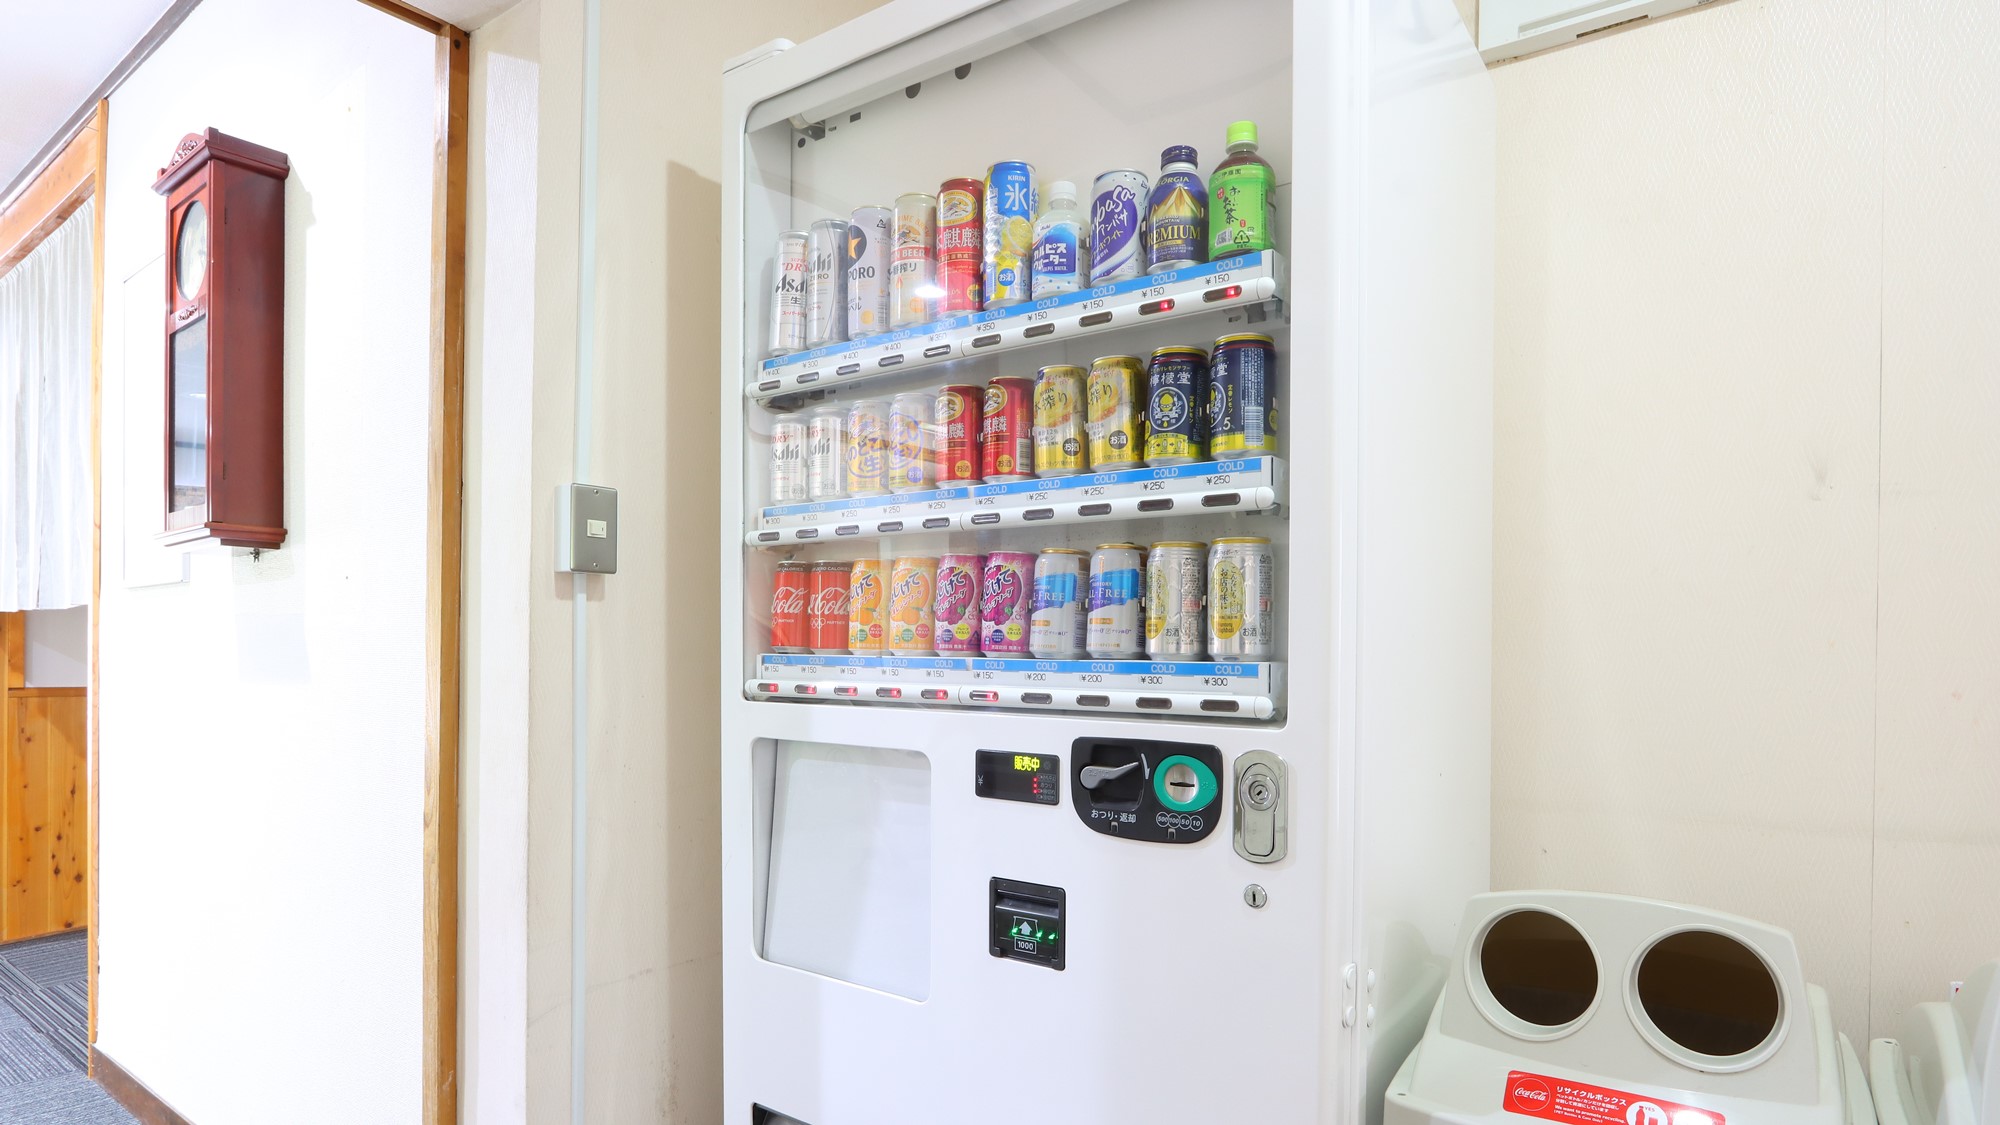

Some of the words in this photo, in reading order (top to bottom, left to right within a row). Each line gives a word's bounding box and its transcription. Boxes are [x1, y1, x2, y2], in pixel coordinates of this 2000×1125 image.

[902, 248, 926, 258] BEER
[1034, 243, 1066, 261] カルピス
[1216, 258, 1244, 272] COLD
[1152, 272, 1178, 285] COLD
[1205, 273, 1230, 285] ¥150
[1092, 285, 1116, 297] COLD
[1142, 287, 1164, 298] ¥150
[1036, 298, 1058, 310] COLD
[1082, 300, 1104, 310] ¥150
[985, 310, 1006, 320] COLD
[1027, 311, 1048, 322] ¥150
[976, 322, 996, 332] ¥350
[892, 330, 910, 340] COLD
[1110, 436, 1126, 444] お酒
[1064, 443, 1080, 452] お酒
[1217, 462, 1244, 472] COLD
[1153, 468, 1178, 478] COLD
[1094, 474, 1117, 484] COLD
[1206, 474, 1230, 485] ¥250
[987, 486, 1008, 494] COLD
[1038, 480, 1060, 490] COLD
[1143, 481, 1166, 490] ¥250
[936, 490, 956, 499] COLD
[1084, 487, 1104, 496] ¥250
[848, 500, 866, 508] COLD
[890, 495, 908, 503] COLD
[883, 506, 900, 514] ¥250
[928, 502, 946, 510] ¥250
[1220, 568, 1228, 610] お店の味に
[1166, 628, 1180, 636] お酒
[1242, 628, 1257, 637] お酒
[934, 660, 954, 668] COLD
[984, 661, 1004, 670] COLD
[1036, 662, 1058, 671] COLD
[1091, 662, 1114, 672] COLD
[1150, 664, 1176, 674] COLD
[1215, 665, 1242, 675] COLD
[1027, 673, 1046, 681] ¥200
[1081, 674, 1102, 683] ¥200
[1140, 676, 1163, 684] ¥300
[1204, 677, 1228, 686] ¥300
[1014, 756, 1040, 772] 販売中
[1091, 809, 1136, 823] おつり・返却
[1018, 941, 1034, 950] 1000
[1556, 1086, 1626, 1106] リサイクルボックス
[1582, 1110, 1602, 1118] promote
